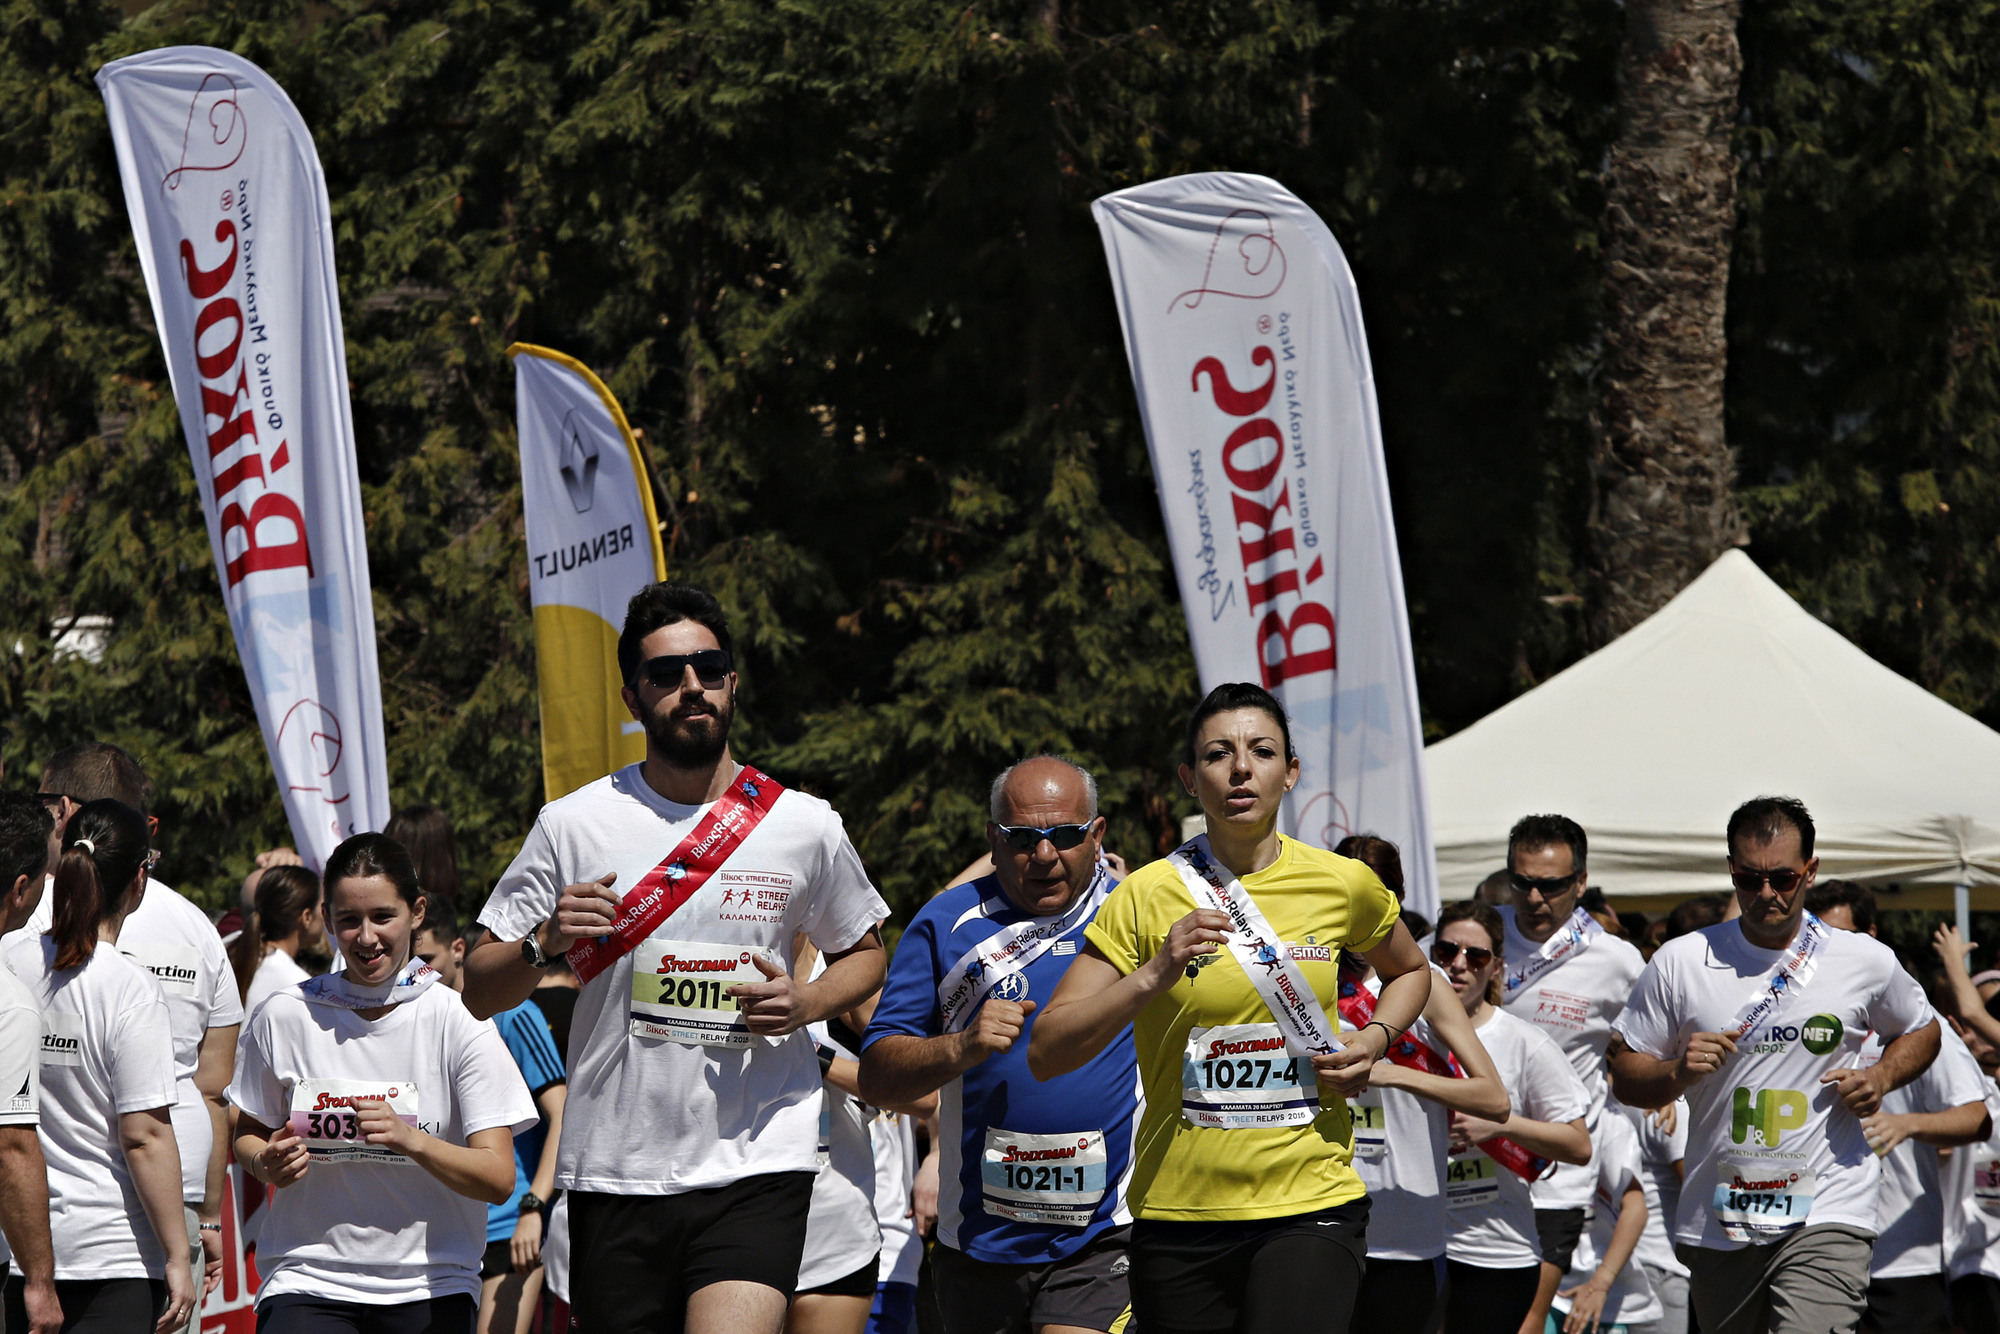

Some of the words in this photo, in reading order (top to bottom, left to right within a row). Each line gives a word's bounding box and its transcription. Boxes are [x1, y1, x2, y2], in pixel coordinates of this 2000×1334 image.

[745, 875, 769, 883] STREET
[770, 877, 792, 886] RELAYS
[757, 890, 790, 901] STREET
[757, 901, 787, 912] RELAYS
[719, 913, 767, 922] ΚΑΛΑΜΑΤΑ
[671, 1030, 699, 1039] STREET
[700, 1033, 730, 1043] RELAYS
[1803, 1027, 1835, 1042] NET
[1202, 1057, 1300, 1089] 1027-4
[1226, 1115, 1255, 1123] STREET
[1256, 1113, 1285, 1122] RELAYS
[307, 1113, 358, 1140] 303
[1004, 1164, 1084, 1191] 1021-1
[1729, 1191, 1793, 1216] 1017-1
